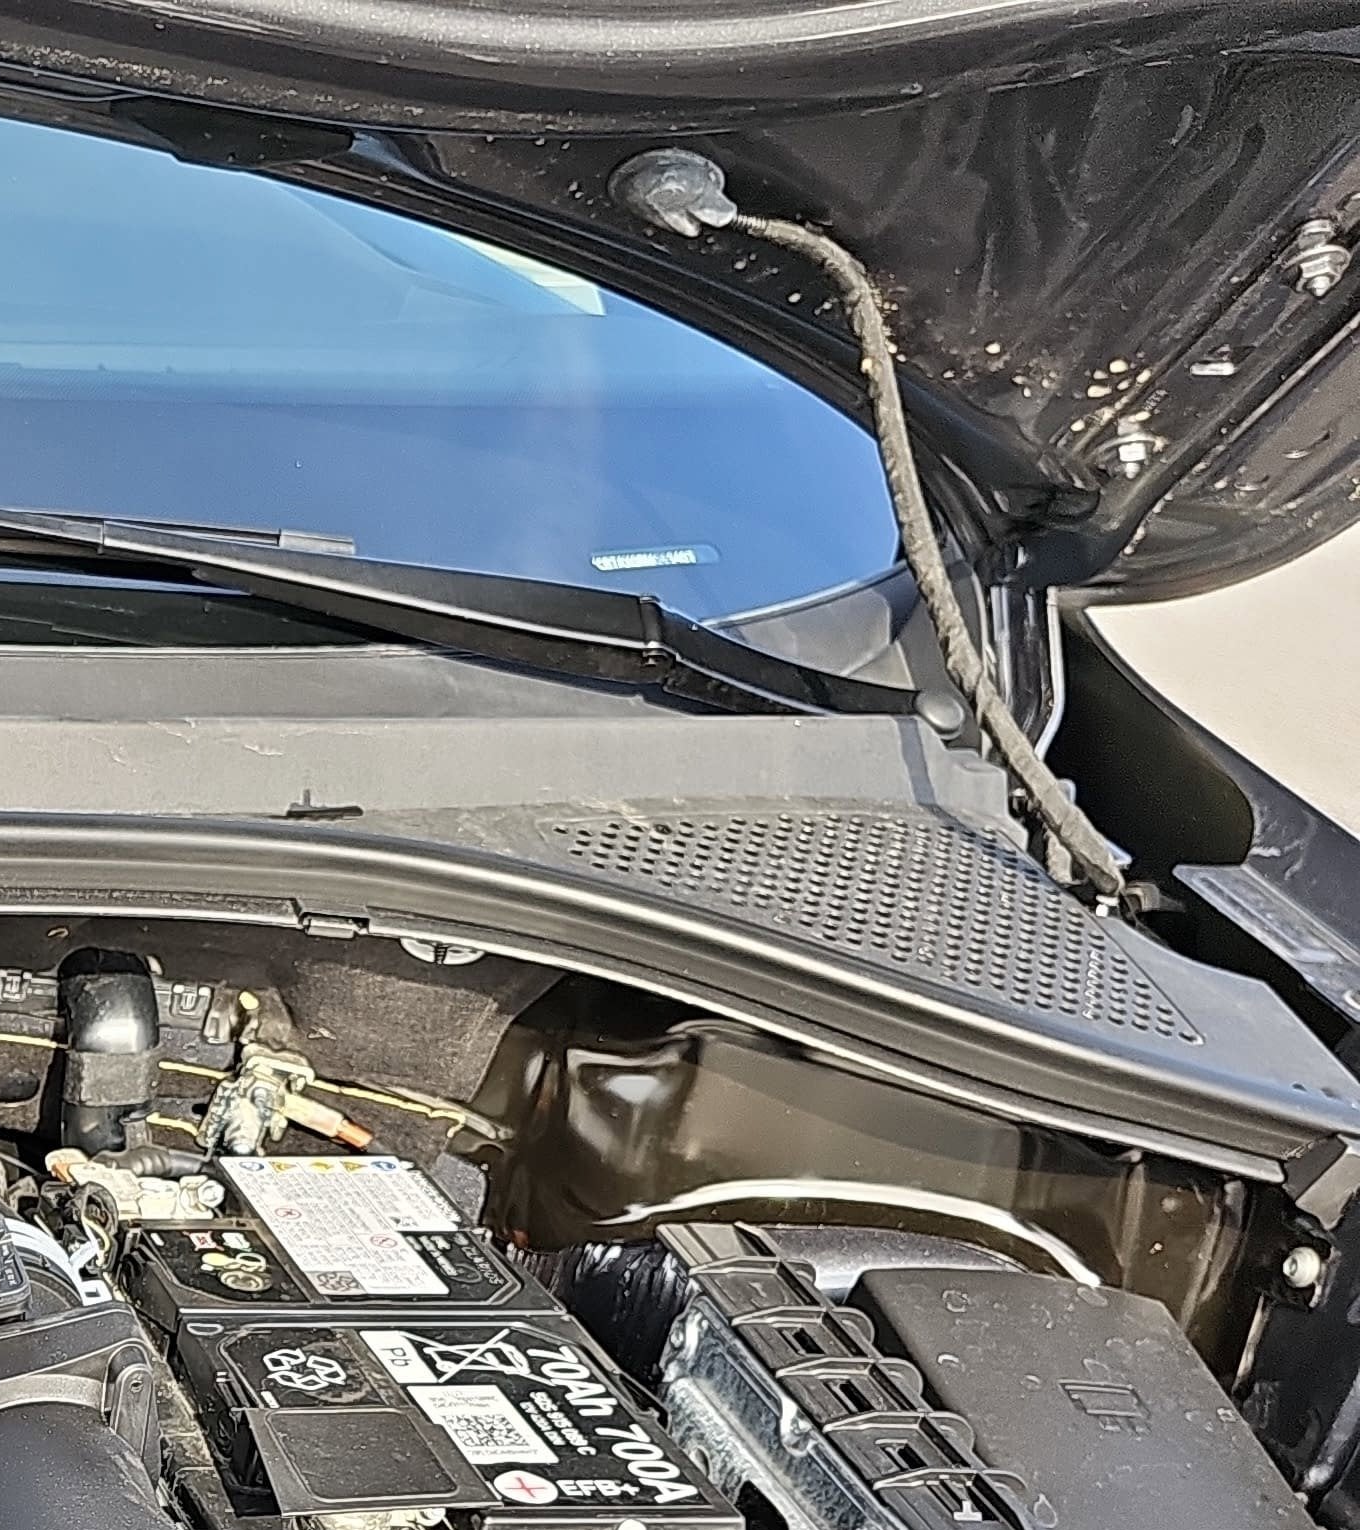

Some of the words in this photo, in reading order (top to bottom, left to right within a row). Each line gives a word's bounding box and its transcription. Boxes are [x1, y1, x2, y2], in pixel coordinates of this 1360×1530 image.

[388, 1347, 411, 1368] Pb
[527, 1346, 618, 1416] 70Ah
[594, 1424, 698, 1504] 700A
[555, 1479, 640, 1498] EFB+
